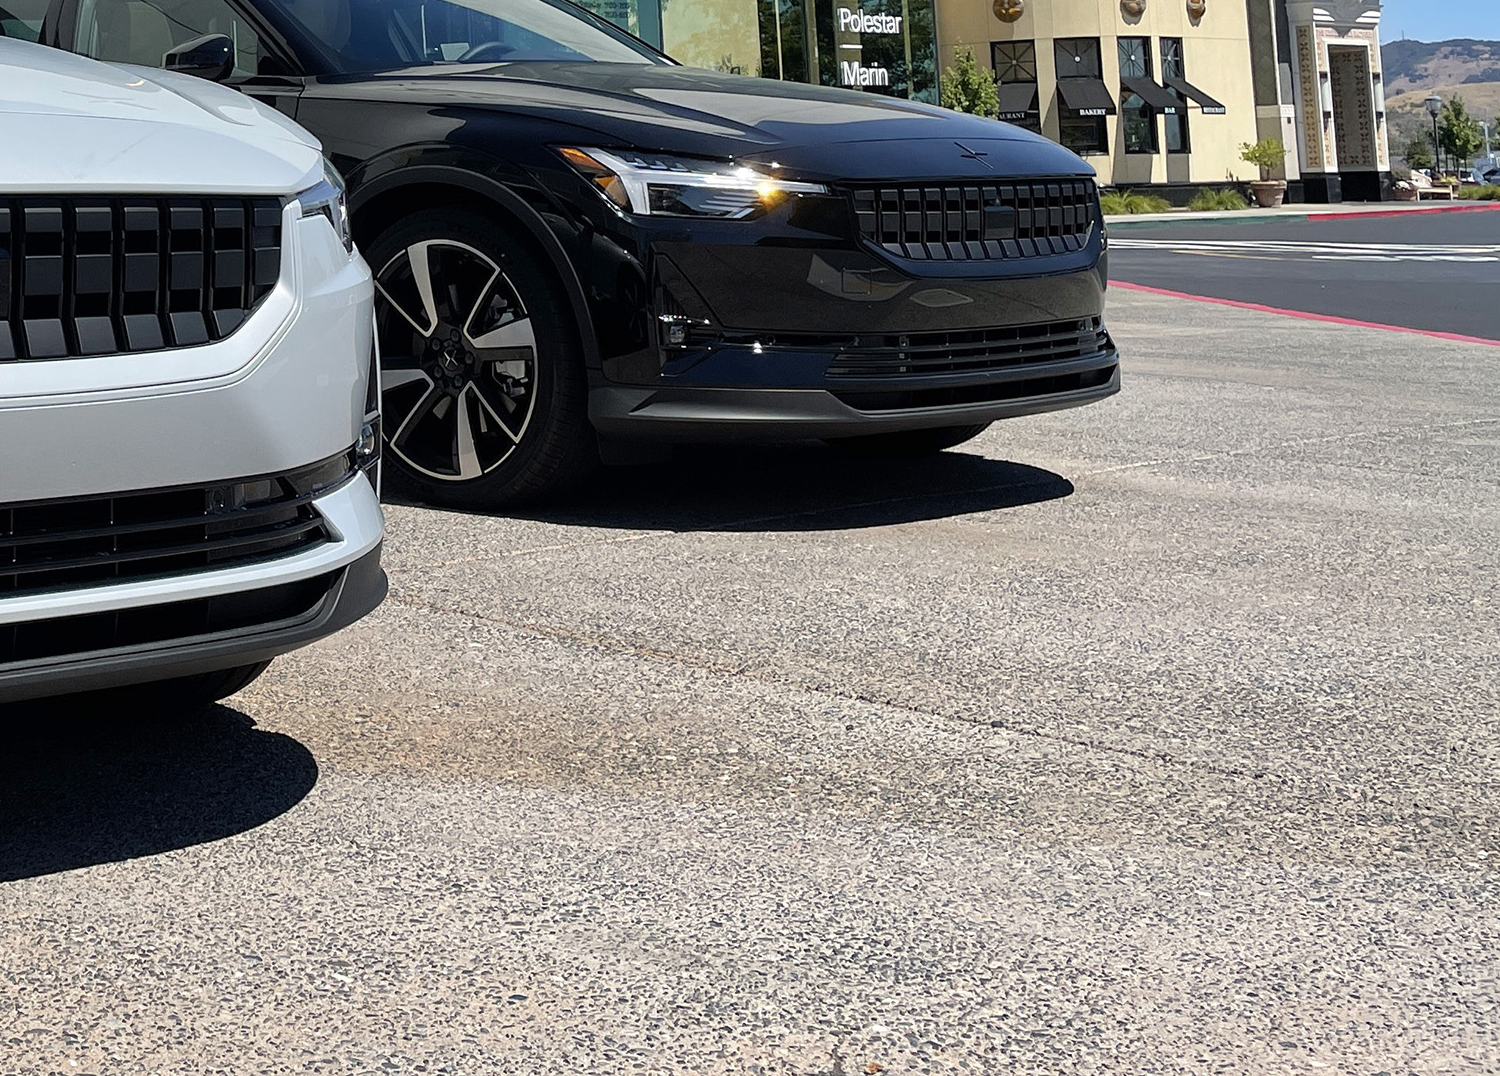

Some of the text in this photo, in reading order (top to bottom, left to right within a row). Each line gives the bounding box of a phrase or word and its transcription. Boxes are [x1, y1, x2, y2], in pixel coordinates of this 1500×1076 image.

[838, 7, 902, 33] Polestar
[841, 61, 888, 86] Marin
[1079, 108, 1107, 116] BAKERY
